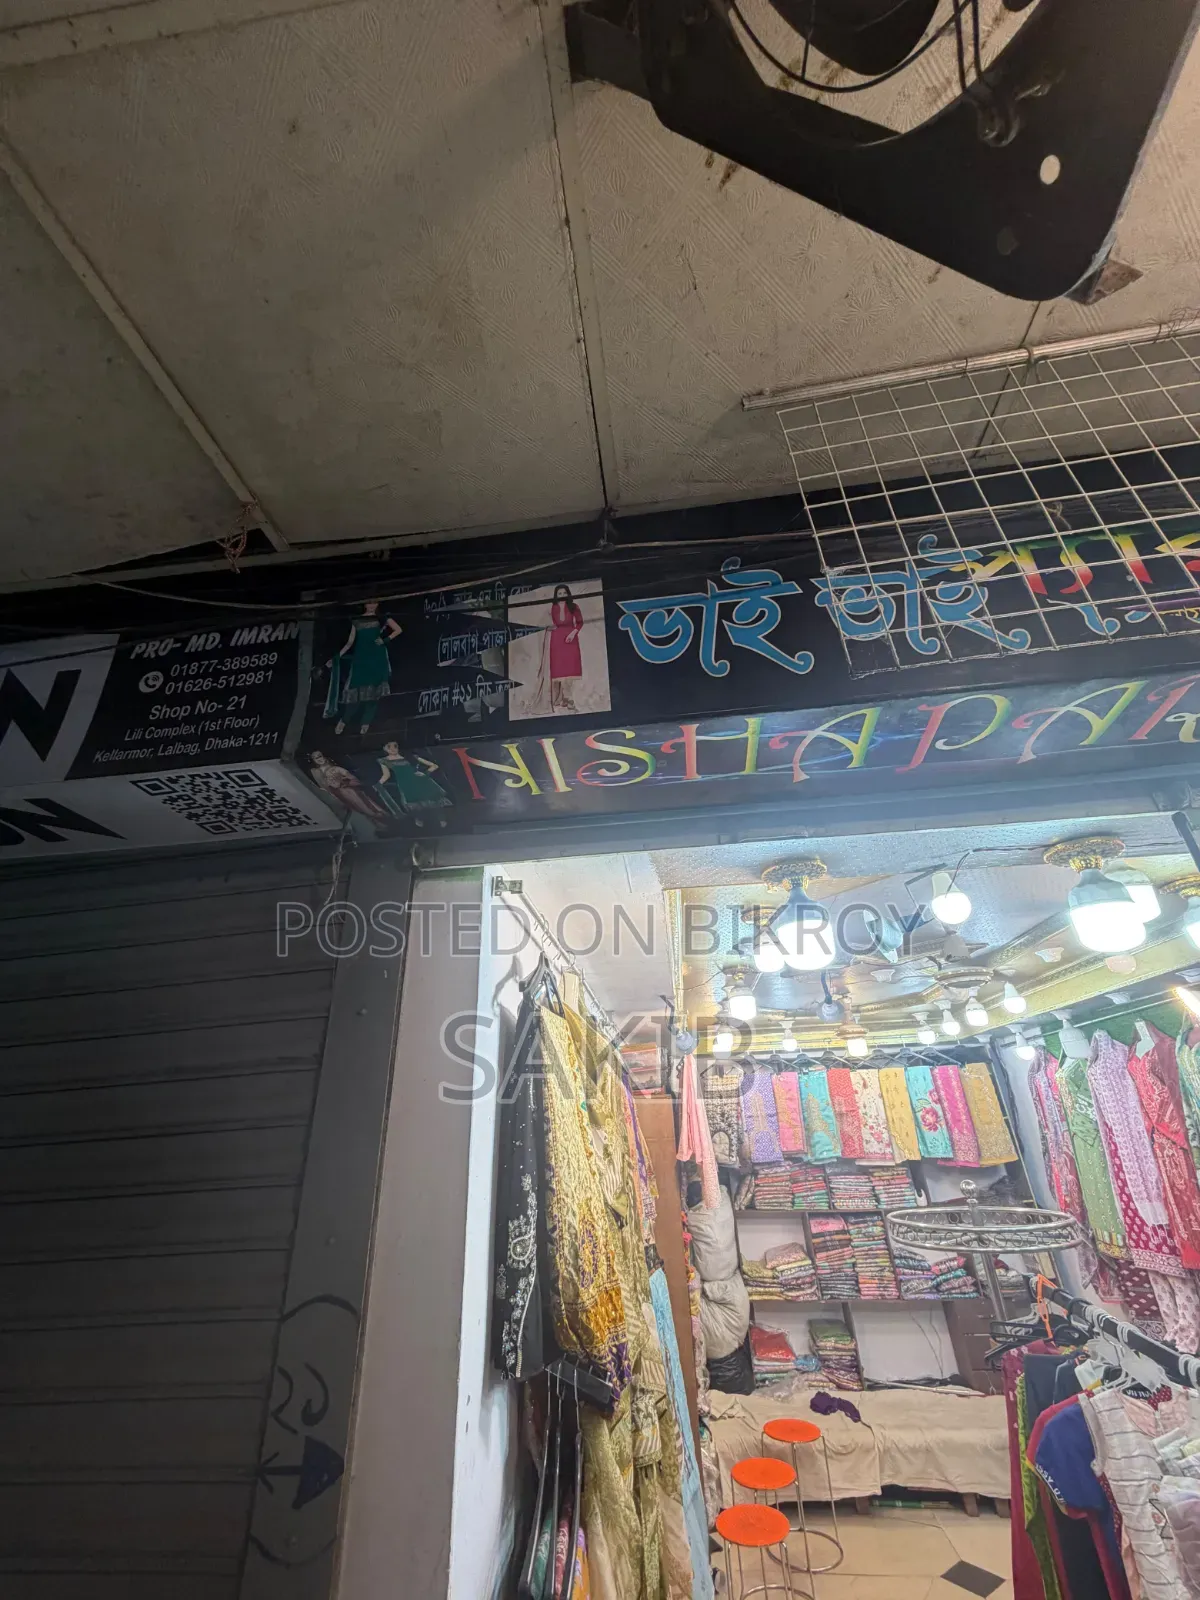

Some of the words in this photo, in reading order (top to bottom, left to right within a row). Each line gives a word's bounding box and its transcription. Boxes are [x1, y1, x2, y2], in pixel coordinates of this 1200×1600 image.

[616, 556, 815, 678] ভাই
[810, 533, 1032, 654] ভাই
[129, 637, 182, 660] PRO-
[184, 631, 224, 653] MD.
[230, 620, 300, 647] IMRAN
[169, 651, 279, 677] 01877-389589
[164, 669, 275, 695] 01626-512981
[148, 703, 191, 721] Shop
[194, 699, 224, 715] No-
[226, 694, 248, 711] 21
[124, 727, 143, 742] Lili
[144, 723, 196, 741] Complex
[198, 718, 221, 736] (1st
[224, 714, 260, 732] Floor)
[157, 742, 201, 758] Lalbag,
[204, 731, 279, 752] Dhaka-1211
